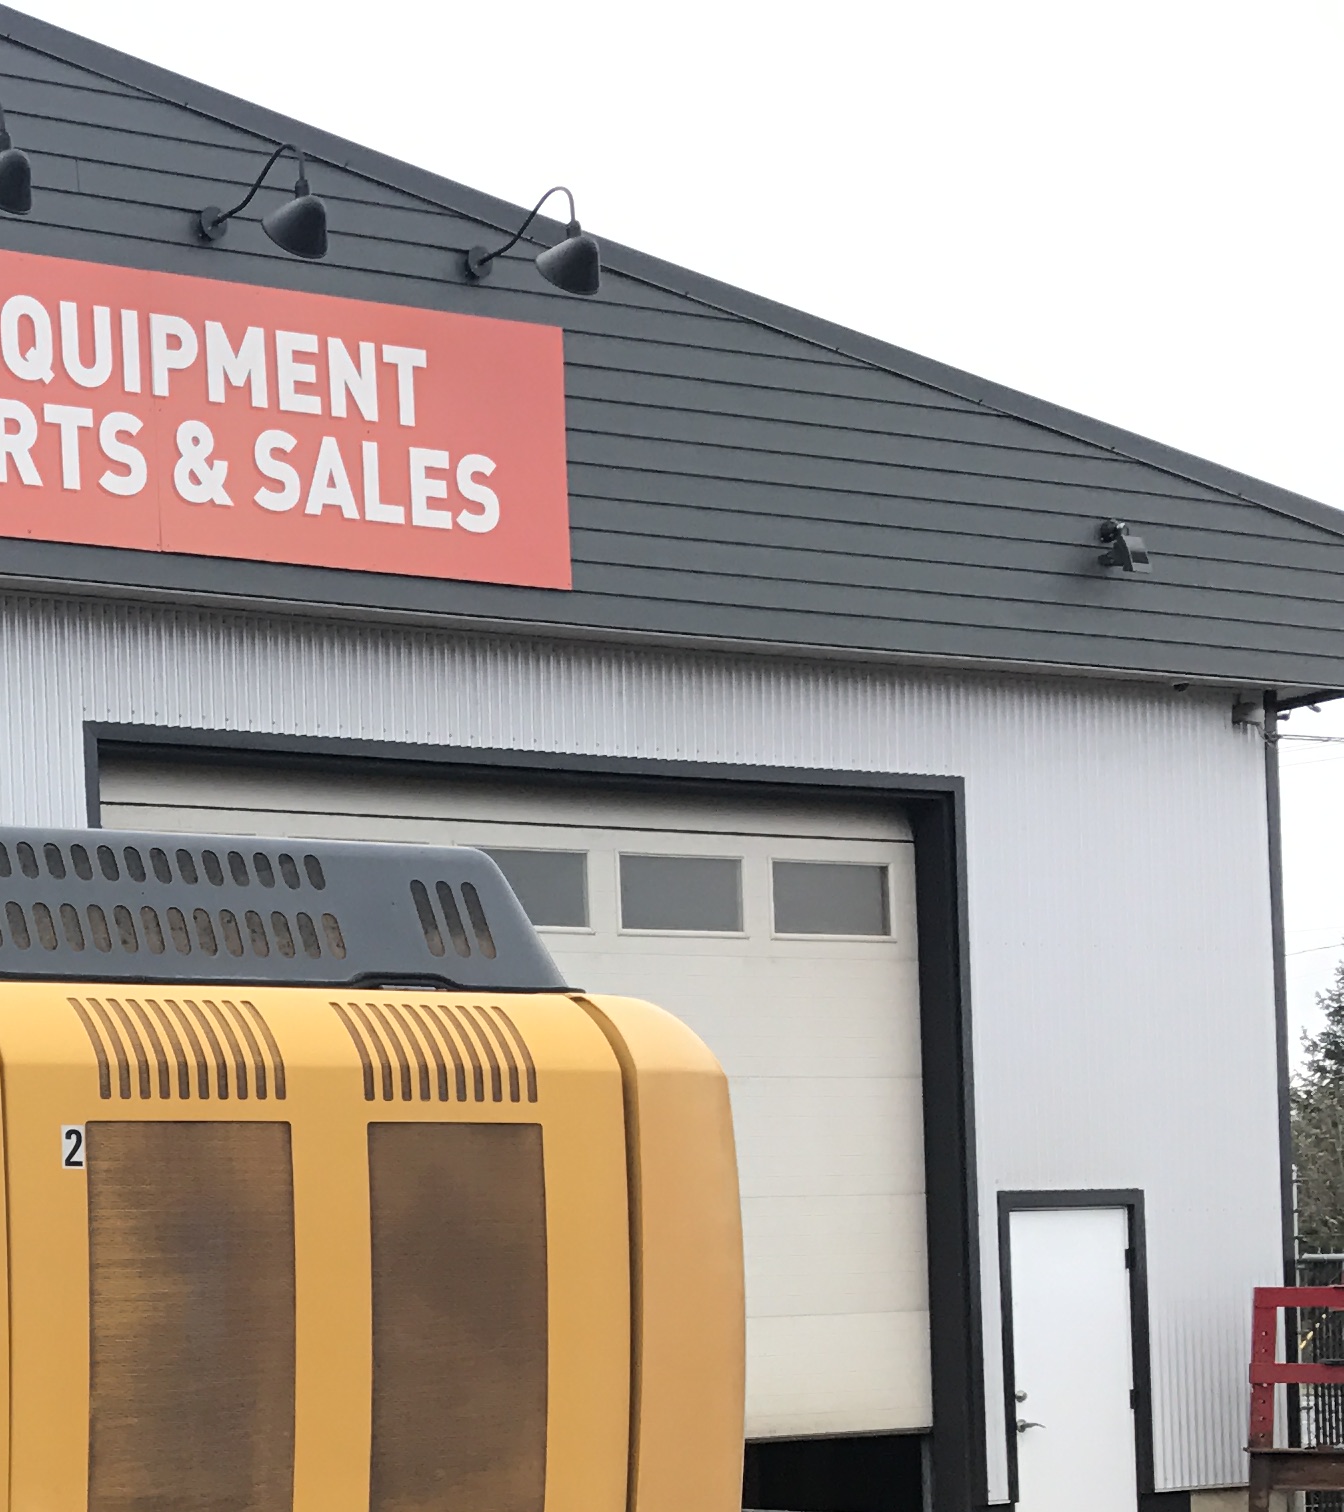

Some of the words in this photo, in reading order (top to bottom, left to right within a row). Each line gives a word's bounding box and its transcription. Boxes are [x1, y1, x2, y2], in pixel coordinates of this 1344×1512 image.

[174, 420, 234, 506] &
[253, 429, 501, 533] SALES
[64, 1128, 84, 1167] 2
